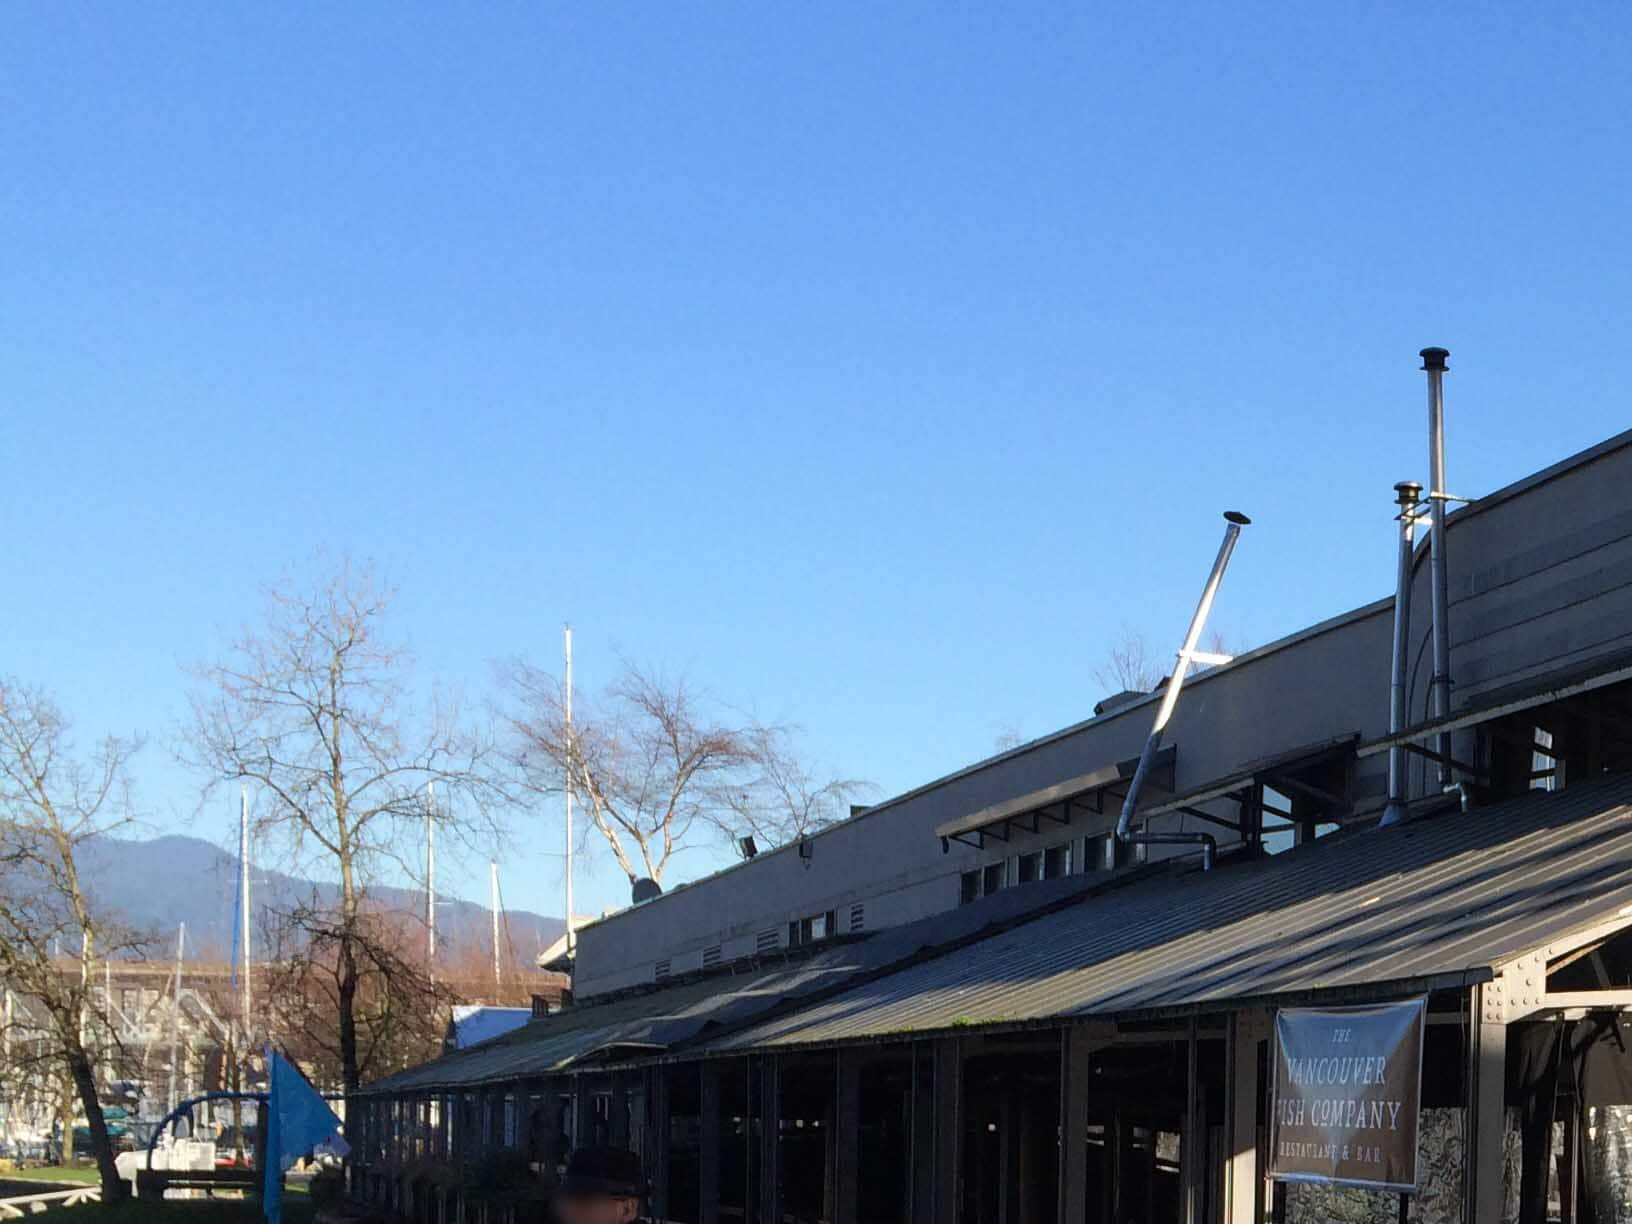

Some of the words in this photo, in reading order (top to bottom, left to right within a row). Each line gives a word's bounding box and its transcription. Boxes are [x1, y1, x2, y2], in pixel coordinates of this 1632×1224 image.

[1331, 1029, 1352, 1043] THE
[1286, 1056, 1387, 1085] VANCOUVER
[1279, 1141, 1338, 1159] RESTAURANT
[1342, 1147, 1350, 1160] &
[1356, 1146, 1381, 1163] BAR
